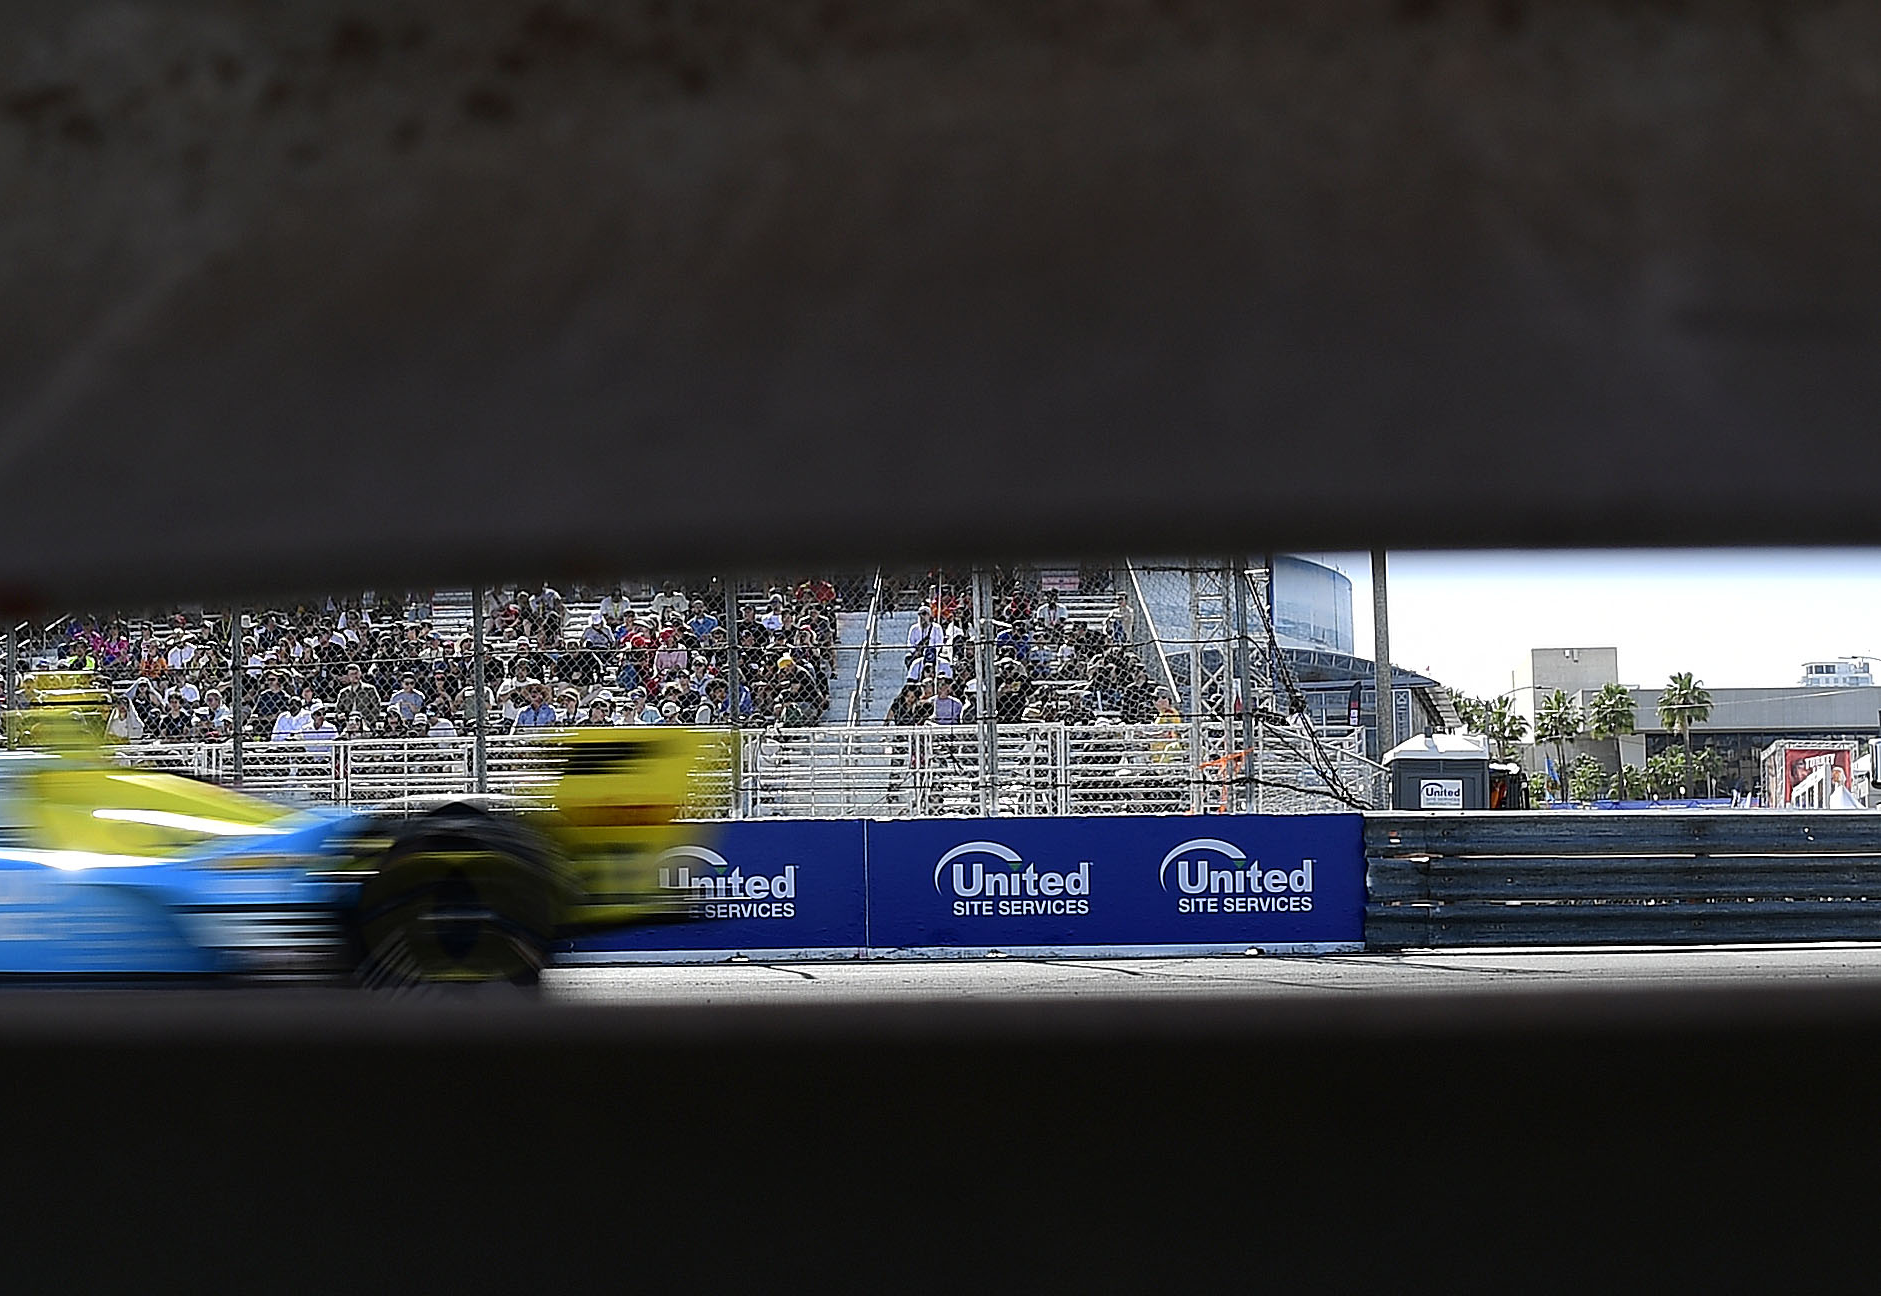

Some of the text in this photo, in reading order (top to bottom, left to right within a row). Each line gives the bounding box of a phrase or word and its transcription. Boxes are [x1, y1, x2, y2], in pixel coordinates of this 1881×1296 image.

[1426, 788, 1460, 797] United
[659, 865, 795, 899] United
[952, 862, 1089, 897] United
[1178, 859, 1312, 894] United
[705, 902, 795, 918] SERVICES
[953, 900, 1089, 915] SITE SERVICES
[1178, 897, 1312, 913] SITE SERVICES
